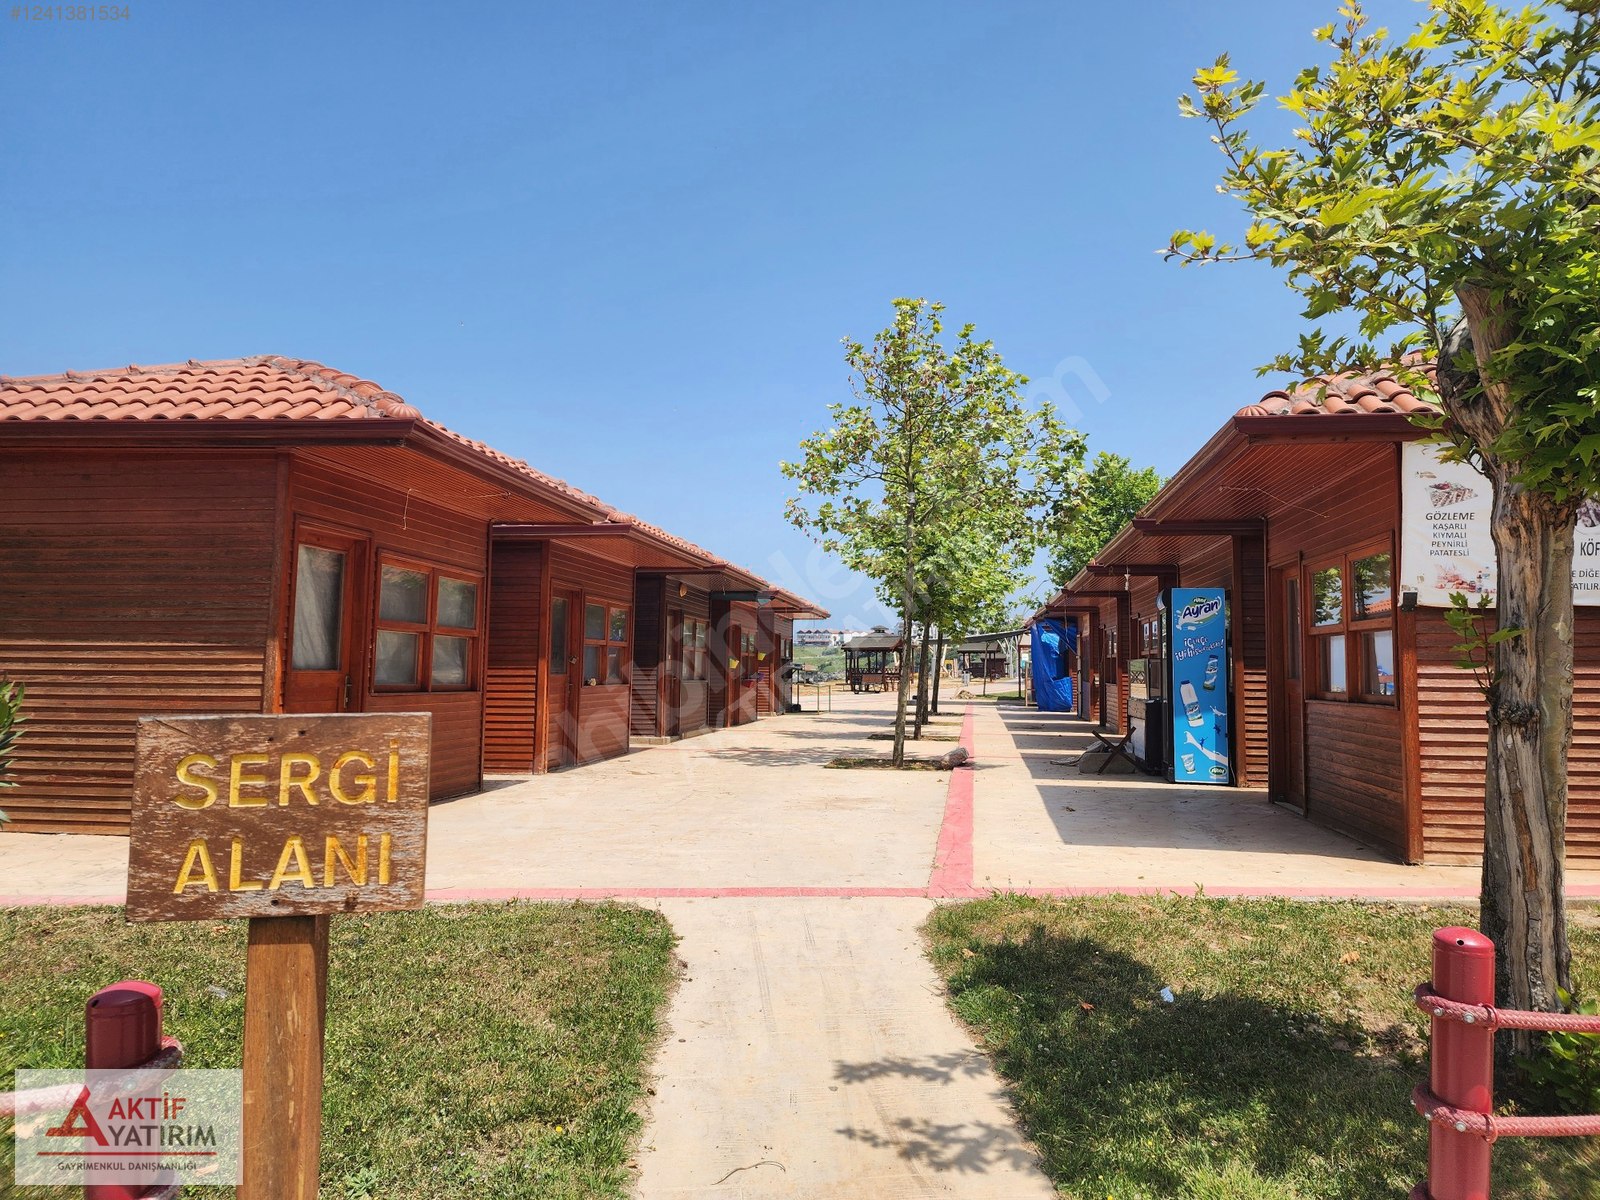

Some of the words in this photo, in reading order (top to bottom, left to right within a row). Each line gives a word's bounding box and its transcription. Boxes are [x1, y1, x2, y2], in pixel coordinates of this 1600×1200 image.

[1425, 510, 1476, 521] GÖZLEME
[1432, 523, 1467, 531] KAŞARLI
[1431, 540, 1468, 548] PEYNİRLİ
[1429, 549, 1470, 557] PATATESLİ
[1182, 600, 1219, 619] Ayran
[173, 738, 400, 810] SERGİ
[173, 832, 393, 894] ALANI
